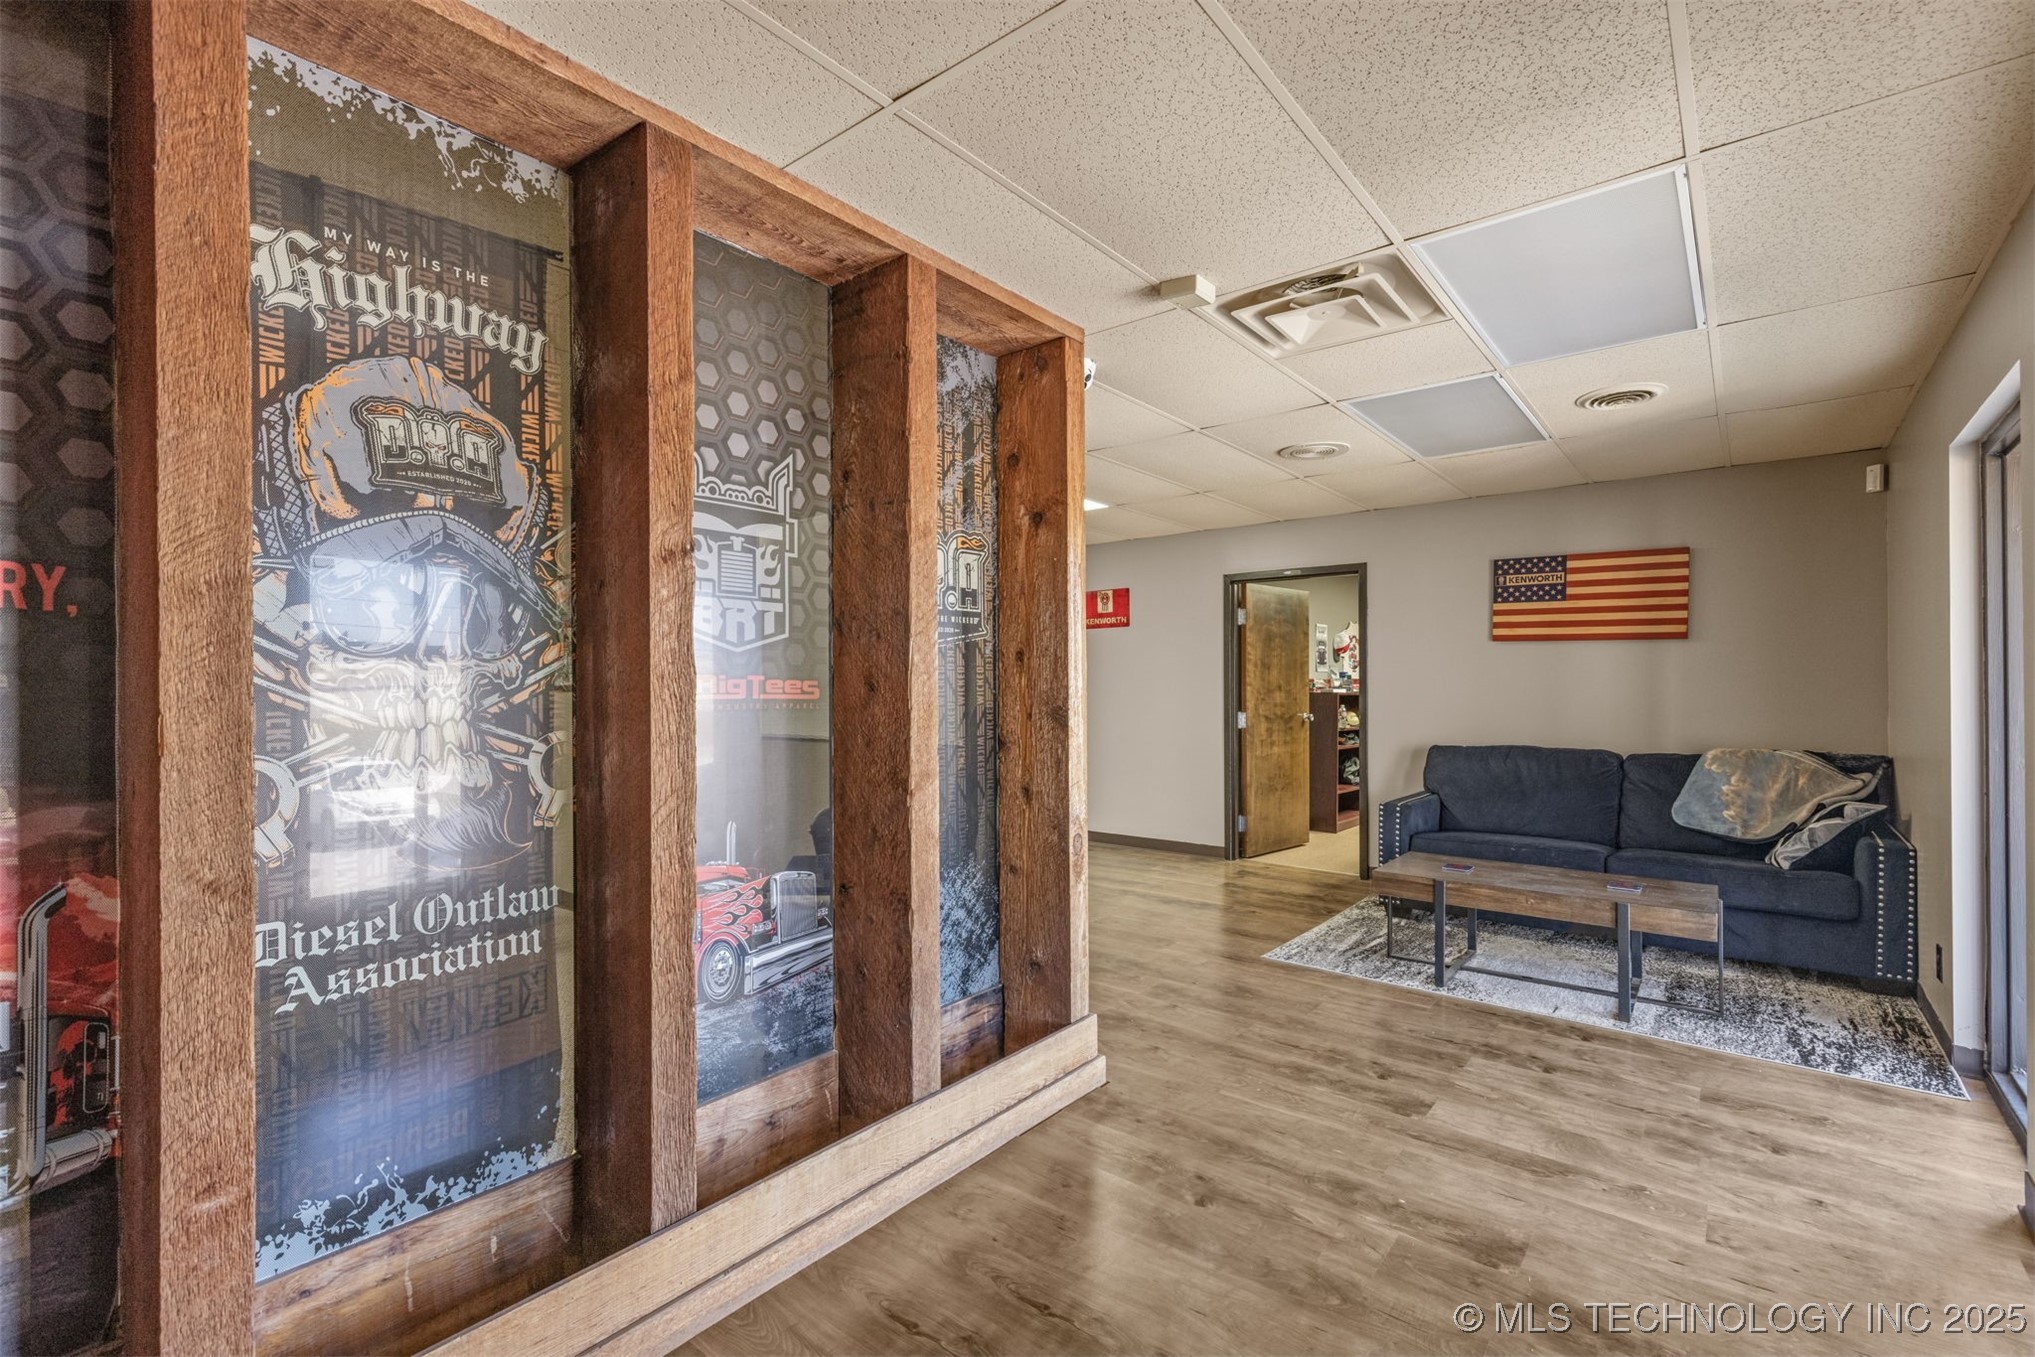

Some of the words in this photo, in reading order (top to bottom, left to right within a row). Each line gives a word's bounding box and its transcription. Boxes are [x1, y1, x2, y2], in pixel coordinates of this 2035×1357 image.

[323, 226, 352, 245] MY
[366, 239, 409, 262] WAY
[422, 256, 440, 271] IS
[453, 266, 490, 287] THE
[250, 226, 549, 376] Highway
[521, 413, 540, 463] WICKE
[408, 470, 454, 483] ESTABLISHED
[0, 559, 78, 618] RY,
[1508, 573, 1563, 584] KENWORTH
[956, 666, 966, 706] WICKED
[976, 666, 985, 705] WICKED
[946, 702, 956, 740] WICKED
[986, 701, 994, 738] WICKED
[957, 737, 966, 777] WICKED
[976, 735, 985, 775] WICKED
[255, 901, 402, 968] Diesel
[413, 882, 560, 935] Outlaw
[274, 928, 543, 1015] Association
